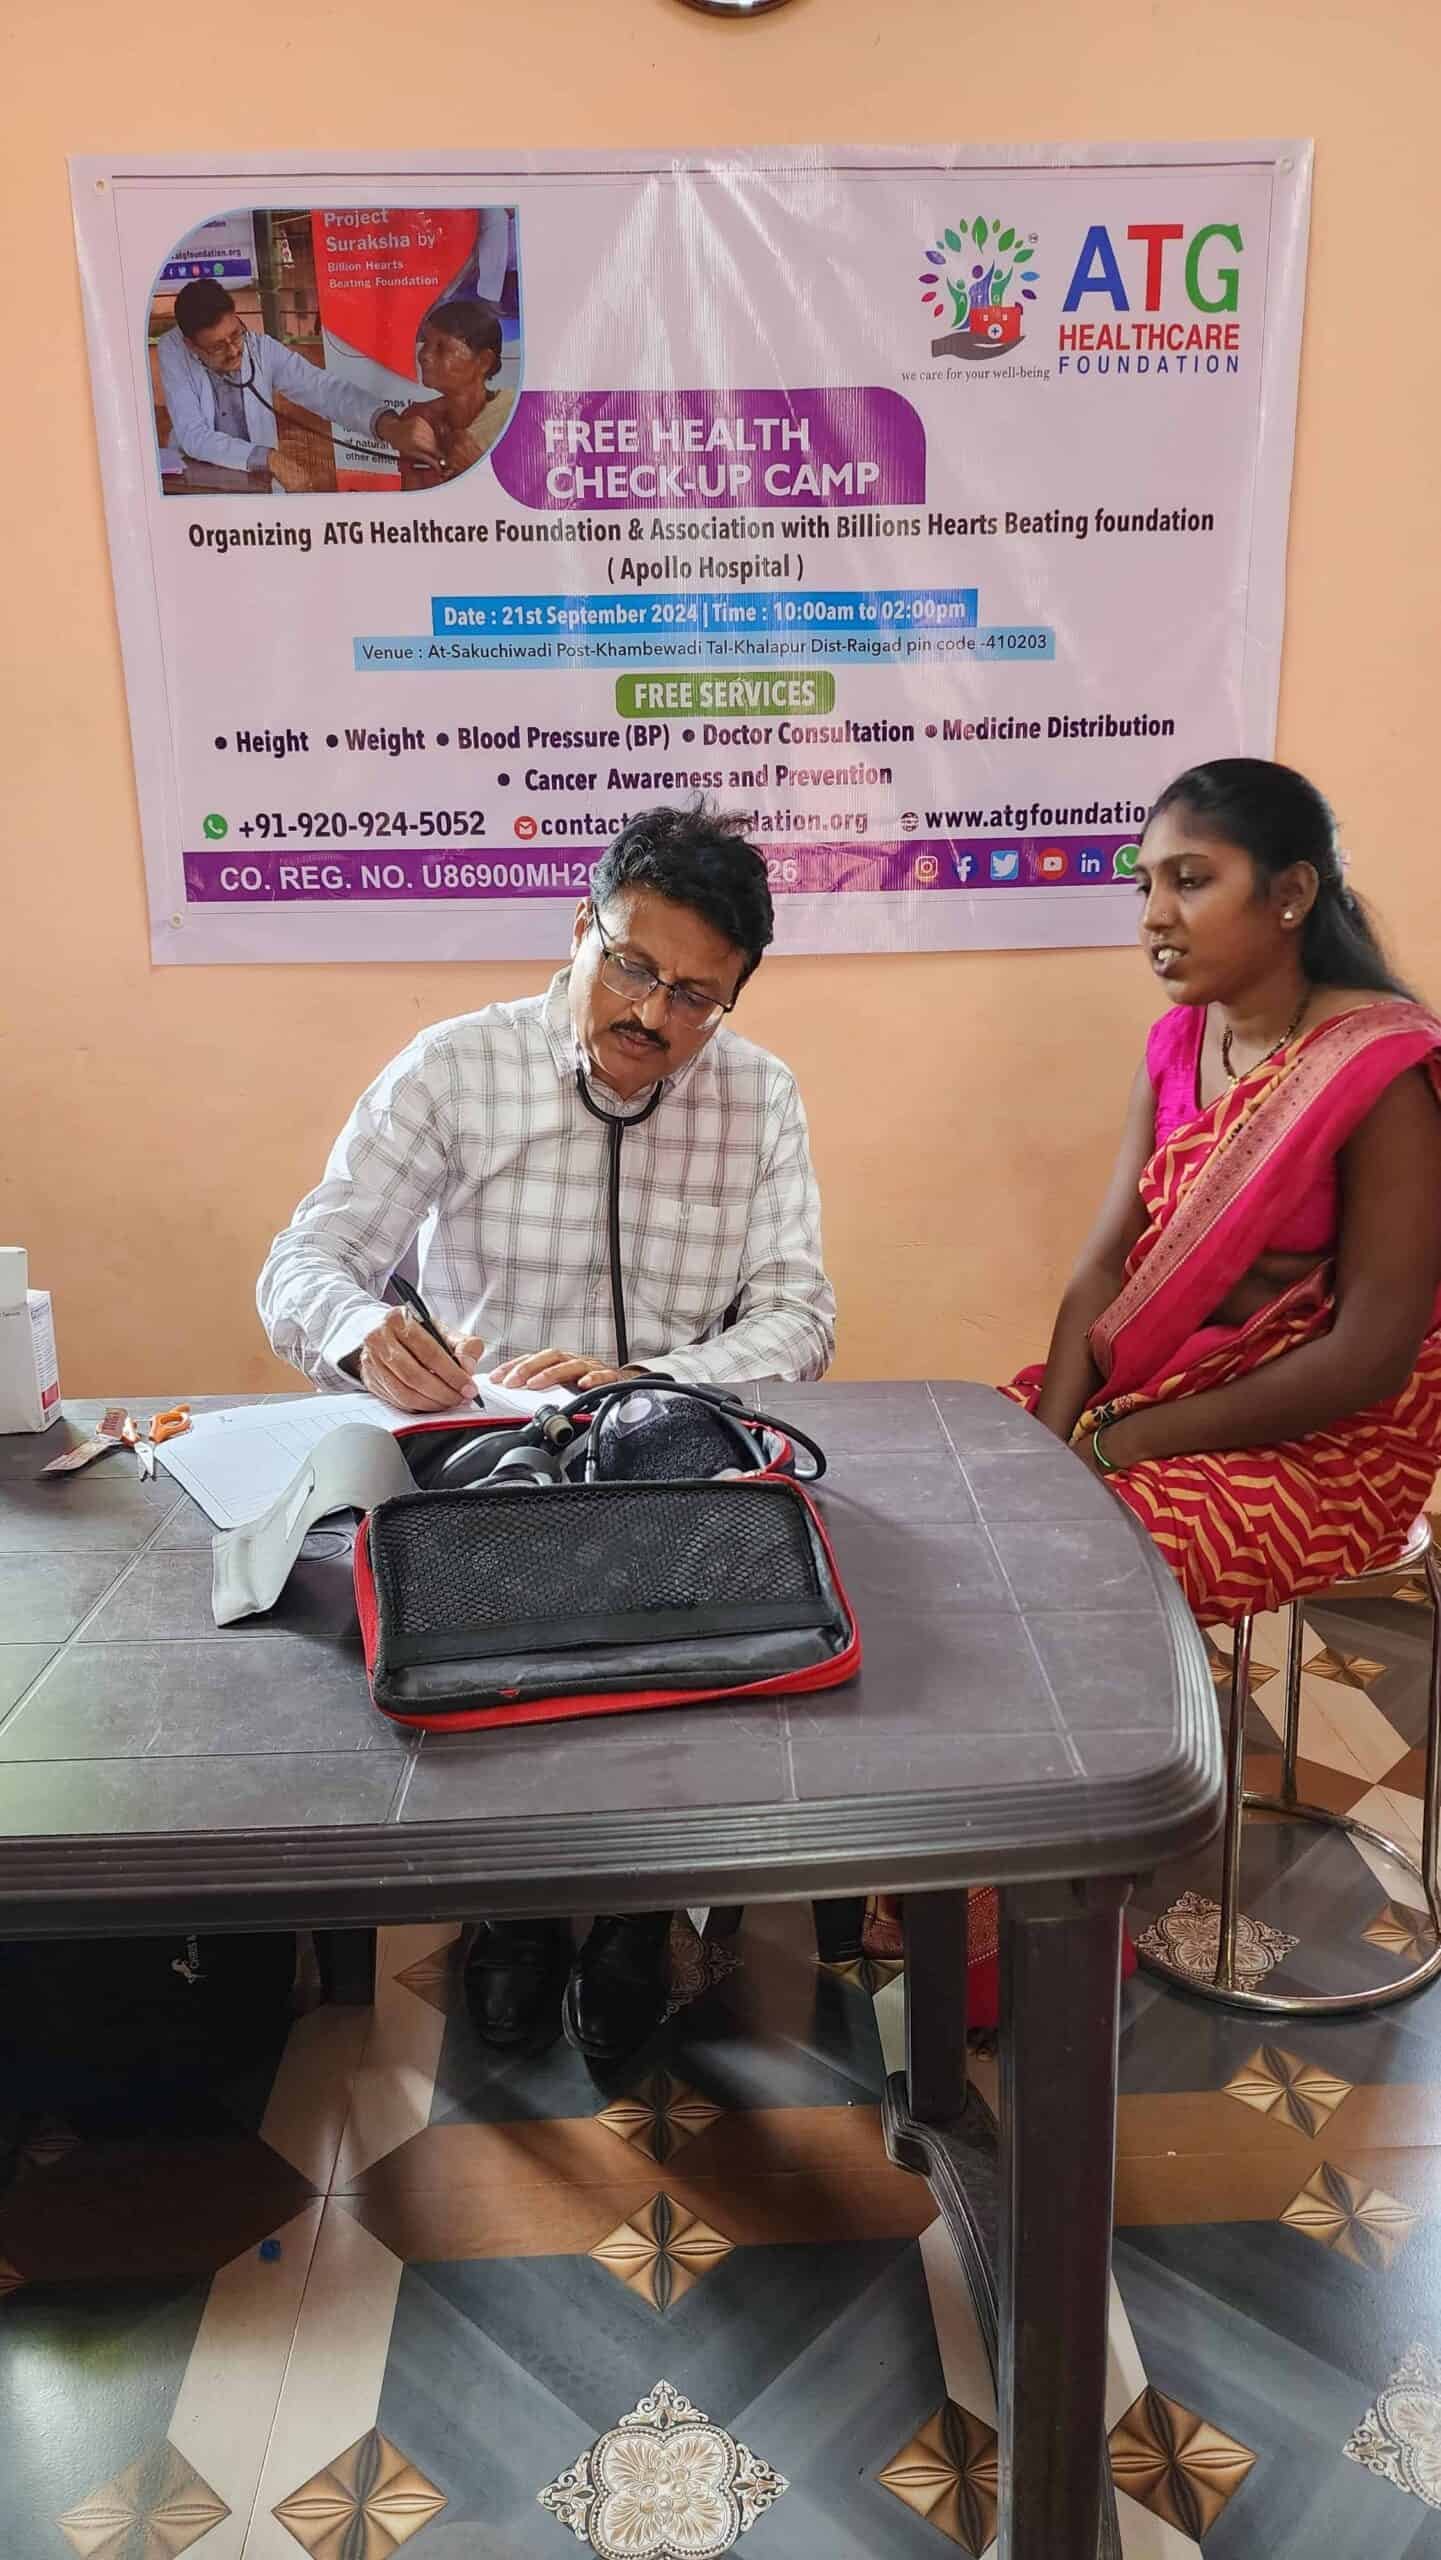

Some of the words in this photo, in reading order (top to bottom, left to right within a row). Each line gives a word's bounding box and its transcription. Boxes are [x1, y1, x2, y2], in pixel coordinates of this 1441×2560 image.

[324, 208, 389, 228] Project
[326, 232, 410, 252] Suraksha
[327, 261, 360, 272] Billion
[366, 260, 403, 271] Hearts
[1062, 223, 1244, 313] ATG
[329, 278, 371, 289] Beating
[375, 275, 438, 287] Foundation
[1058, 323, 1241, 351] HEALTHCARE
[901, 371, 916, 381] we
[919, 370, 943, 381] care
[946, 368, 961, 380] for
[965, 369, 989, 383] your
[993, 365, 1050, 381] well-being
[1058, 355, 1240, 375] FOUNDATION
[544, 418, 640, 453] FREE
[653, 417, 809, 451] HEALTH
[546, 463, 751, 499] CHECK-UP
[764, 462, 880, 497] CAMP
[188, 521, 312, 553] Organizing
[323, 521, 364, 544] ATG
[370, 519, 488, 543] Healthcare
[495, 517, 621, 542] Foundation
[628, 518, 644, 541] &
[650, 515, 774, 541] Association
[782, 515, 829, 539] with
[837, 513, 921, 538] Billions
[928, 512, 998, 537] Hearts
[1005, 509, 1088, 539] Beating
[1095, 507, 1214, 533] foundation
[621, 556, 692, 586] Apollo
[699, 553, 789, 584] Hospital
[444, 605, 486, 627] Date
[502, 605, 543, 626] 21st
[547, 603, 647, 630] September
[651, 603, 698, 624] 2024
[712, 602, 756, 623] Time
[773, 601, 854, 622] 10:00am
[860, 601, 877, 620] to
[881, 600, 966, 625] 02:00pm
[362, 644, 413, 660] Venue
[428, 641, 552, 659] At-Sakuchiwadi
[557, 639, 702, 658] Post-Khambewadi
[706, 638, 806, 657] Tal-Khalapur
[811, 637, 902, 657] Dist-Raigad
[907, 637, 932, 656] pin
[937, 635, 976, 651] code
[634, 681, 693, 710] FREE
[699, 678, 816, 708] SERVICES
[236, 729, 309, 758] Height
[345, 726, 426, 756] Weight
[457, 725, 520, 750] Blood
[527, 726, 620, 749] Pressure
[626, 723, 670, 750] (BP)
[703, 723, 773, 747] Doctor
[778, 719, 915, 745] Consultation
[942, 717, 1041, 742] Medicine
[1047, 714, 1175, 739] Distribution
[525, 768, 597, 791] Cancer
[607, 767, 723, 790] Awareness
[729, 764, 768, 788] and
[775, 762, 892, 787] Prevention
[239, 811, 486, 839] +91-920-924-5052
[926, 800, 1152, 831] www.atgfoundatio
[220, 866, 270, 891] CO.
[279, 865, 352, 890] REG.
[361, 865, 413, 888] NO.
